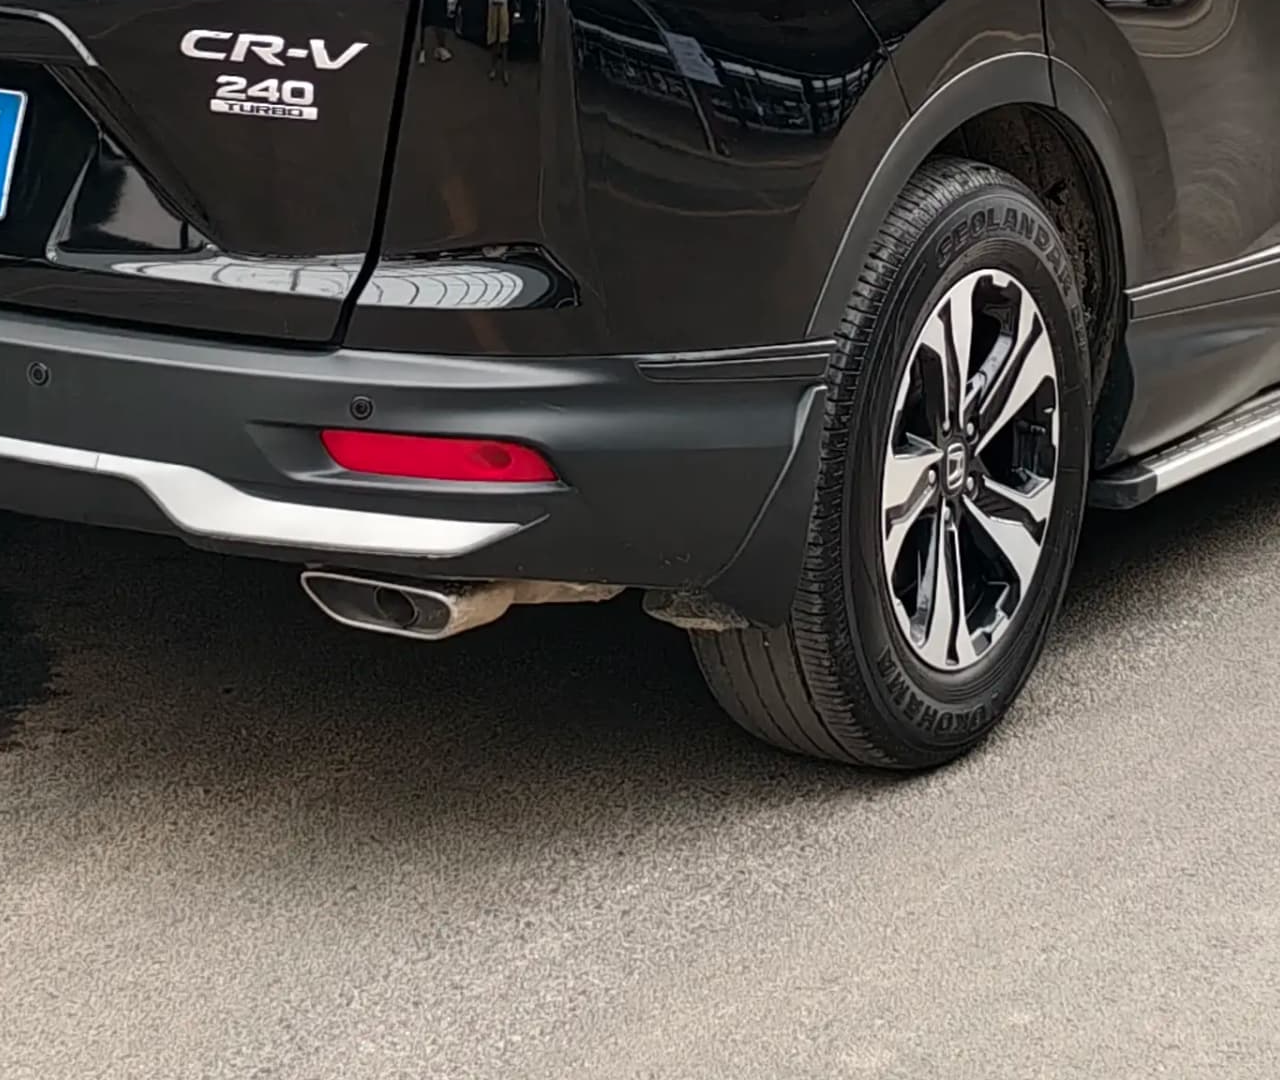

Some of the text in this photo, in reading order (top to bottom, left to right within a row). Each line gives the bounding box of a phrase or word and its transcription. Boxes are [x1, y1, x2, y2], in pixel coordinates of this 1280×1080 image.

[180, 28, 369, 71] CR-V
[215, 74, 315, 106] 240
[223, 102, 305, 118] TURBO
[877, 645, 999, 734] OKOHAMA
